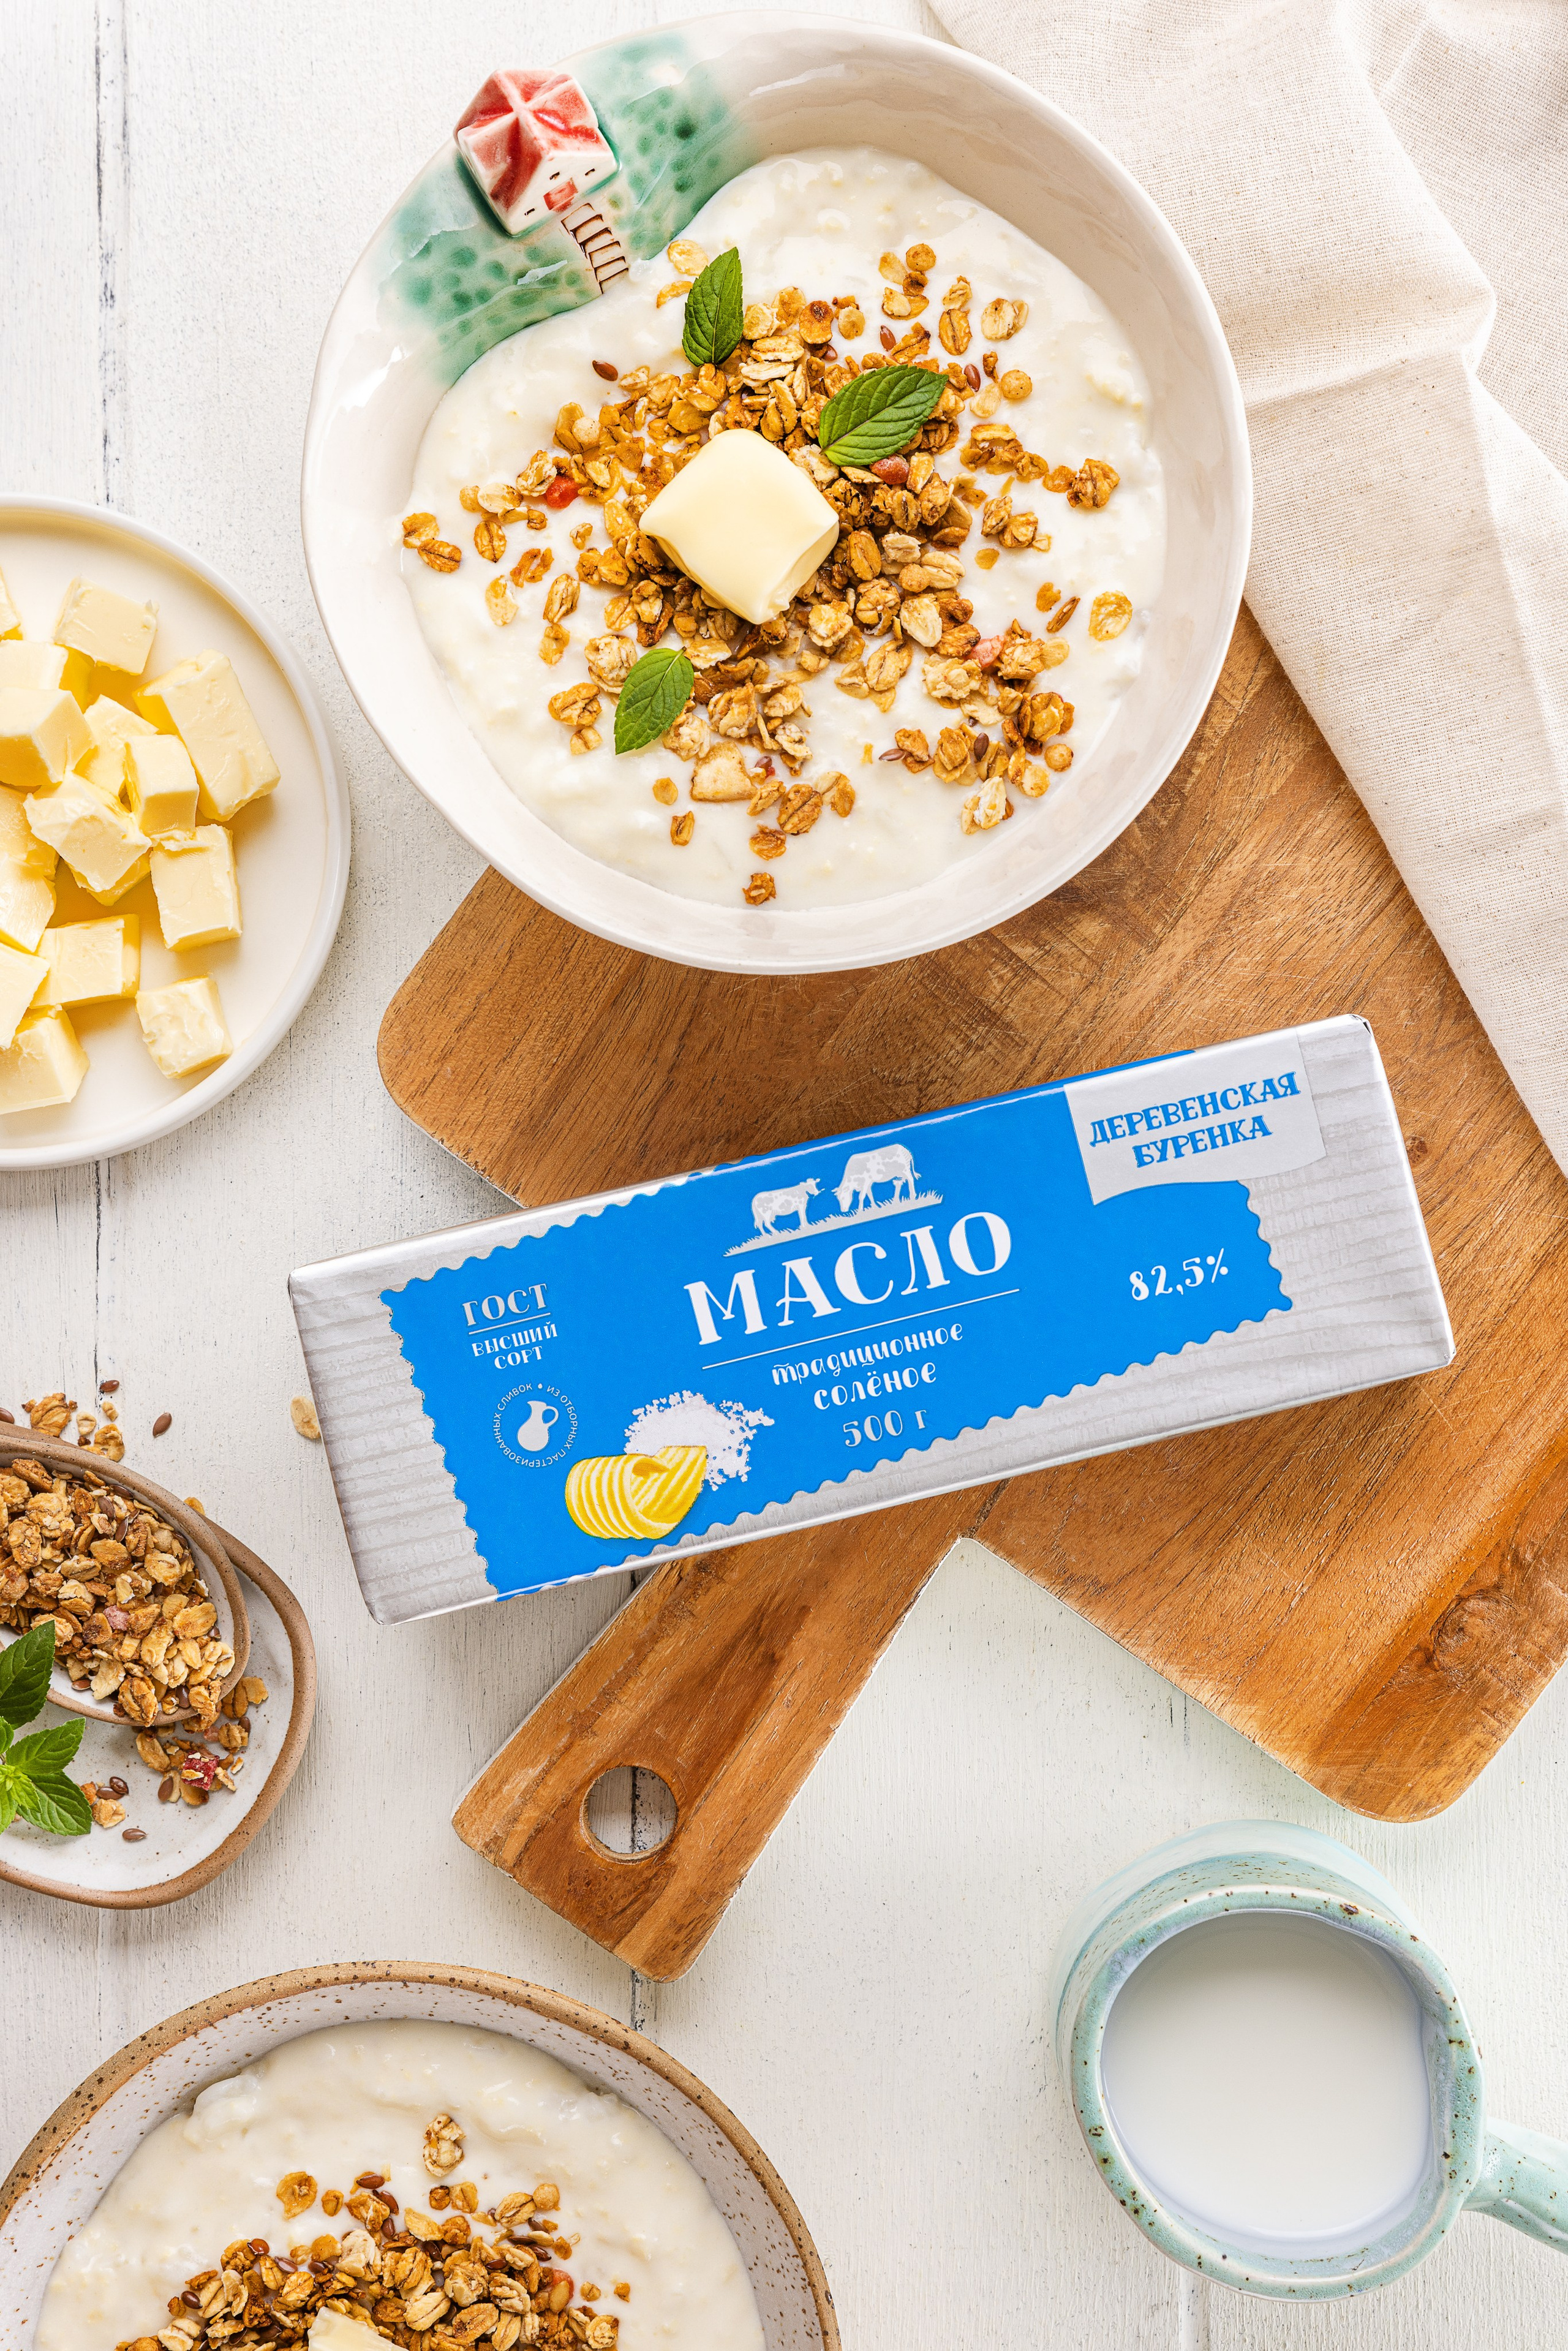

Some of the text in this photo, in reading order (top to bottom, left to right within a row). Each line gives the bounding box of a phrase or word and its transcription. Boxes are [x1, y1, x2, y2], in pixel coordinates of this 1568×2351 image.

[1090, 1071, 1300, 1147] ДЕРЕВЕНСКАЯ
[1132, 1115, 1273, 1168] БУРЕНКА
[684, 1212, 1012, 1345] МАСЛО
[1129, 1248, 1229, 1301] 82,5%
[462, 1283, 548, 1326] ГОСТ
[471, 1321, 558, 1357] ВЫСШИЙ
[494, 1346, 543, 1369] СОРТ
[771, 1323, 963, 1385] традиционное
[813, 1362, 937, 1410] солёное
[492, 1383, 578, 1468] ИЗ ОТБОРНЫХ ПАСТЕРИЗОВАННЫХ СЛИВОК
[843, 1409, 927, 1447] 500 г
